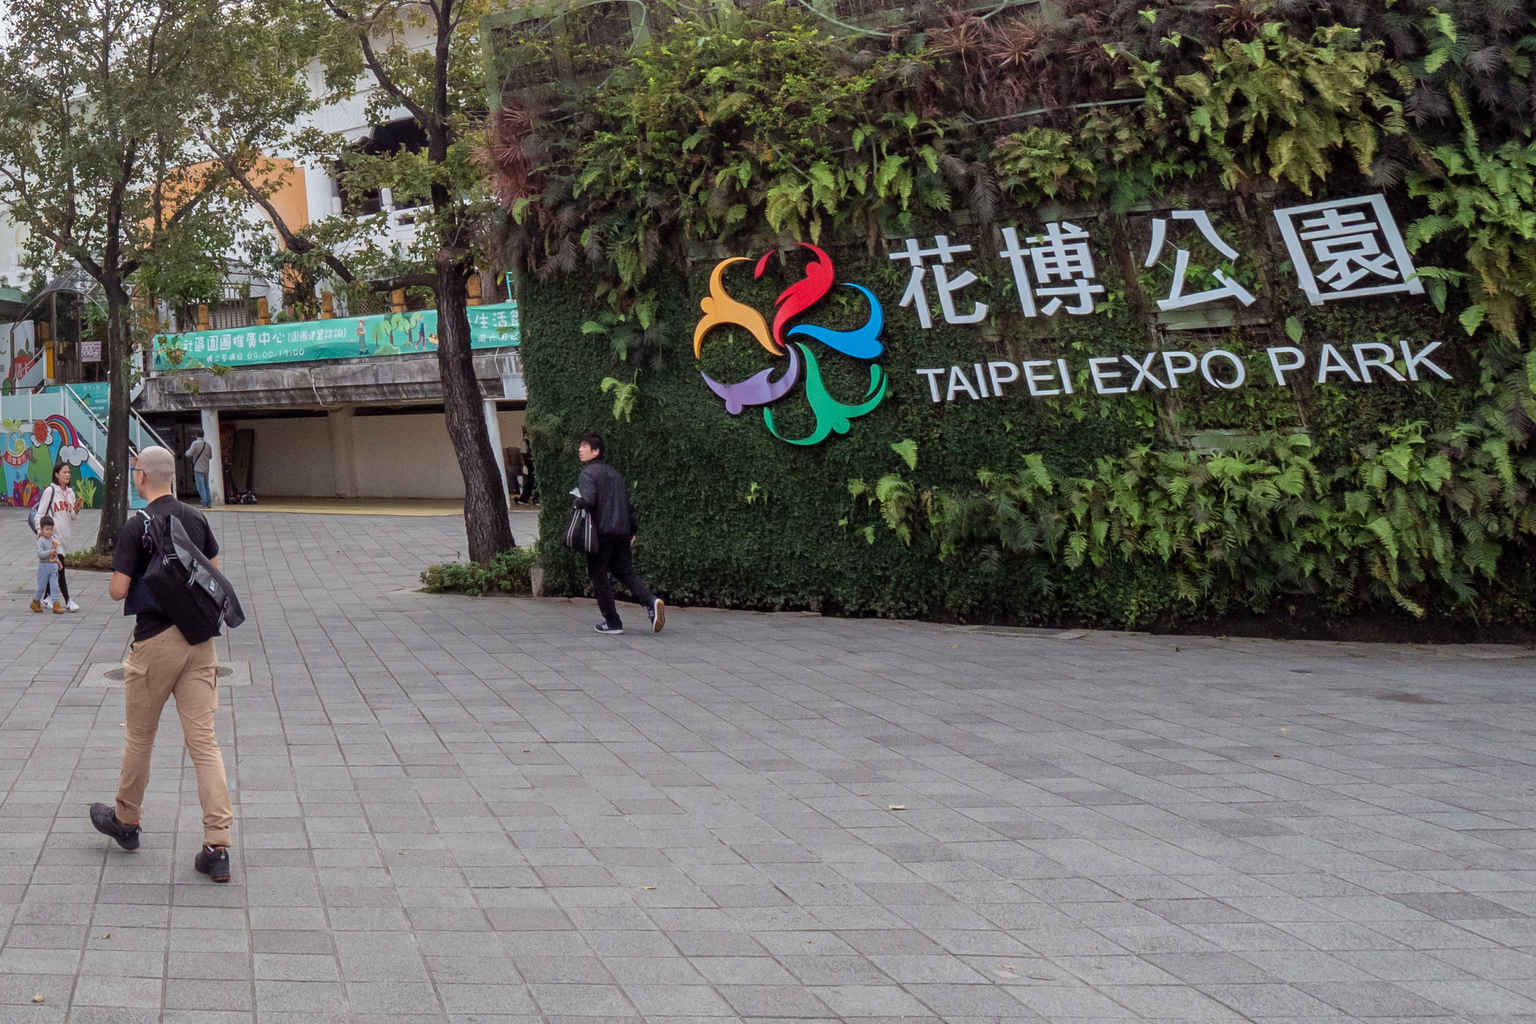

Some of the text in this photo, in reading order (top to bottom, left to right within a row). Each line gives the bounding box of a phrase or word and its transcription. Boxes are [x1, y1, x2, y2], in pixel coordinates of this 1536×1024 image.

[889, 193, 1426, 330] 花博公園
[917, 340, 1452, 403] TAIPEI EXPO PARK
